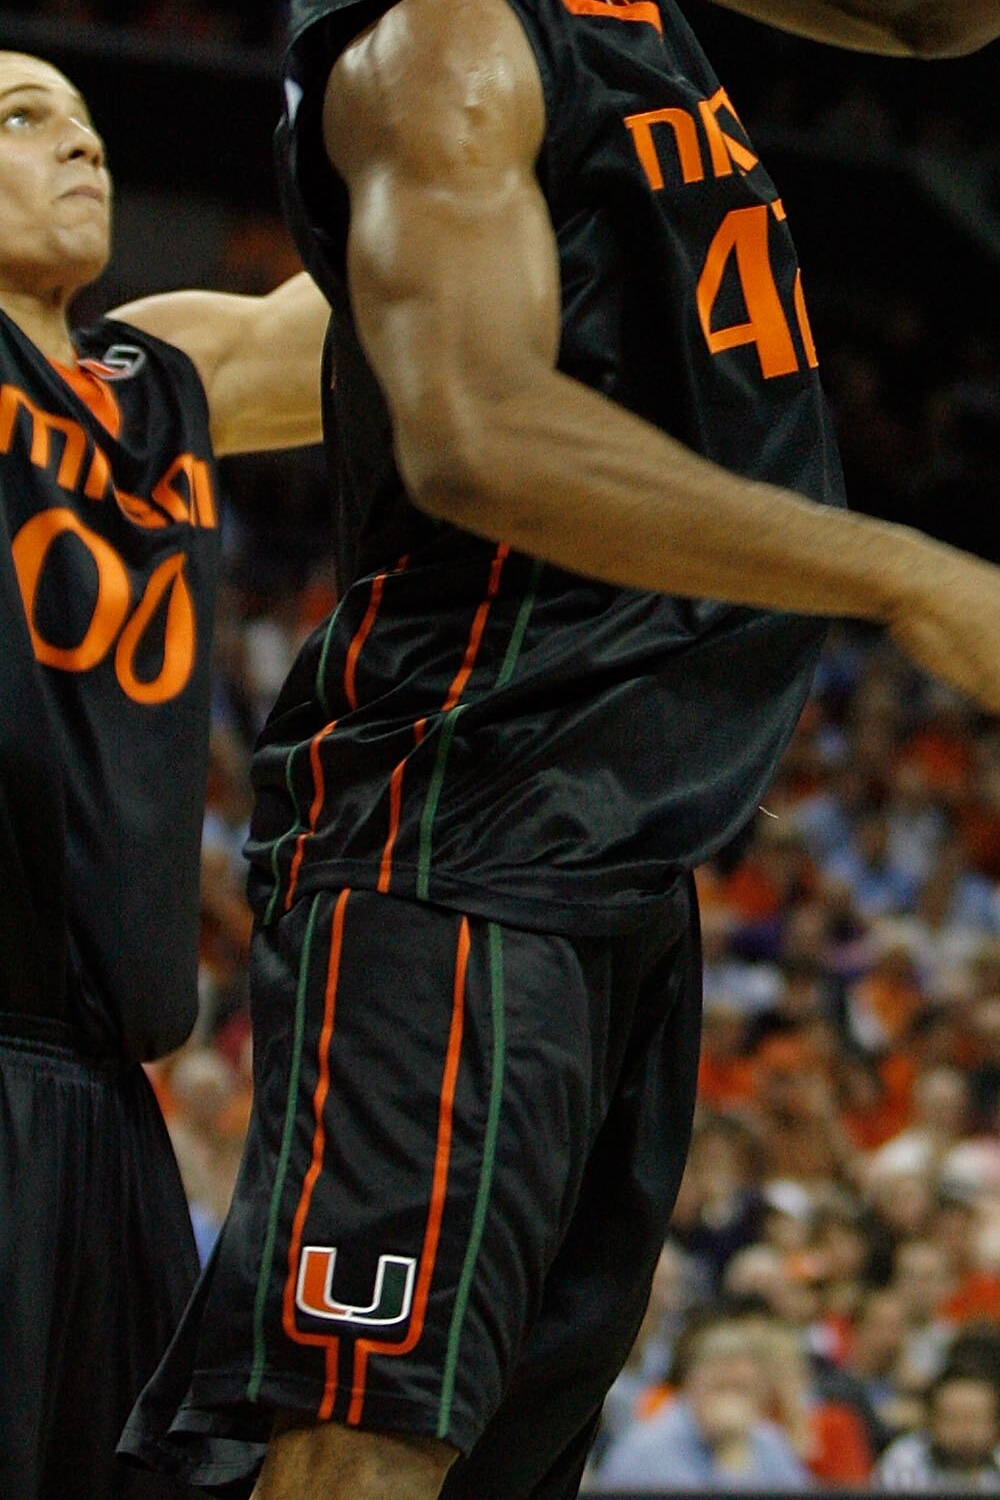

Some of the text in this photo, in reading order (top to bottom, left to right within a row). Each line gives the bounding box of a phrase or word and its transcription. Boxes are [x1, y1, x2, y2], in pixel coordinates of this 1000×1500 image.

[696, 198, 819, 380] 4
[11, 506, 197, 706] 00
[296, 1246, 418, 1327] U
